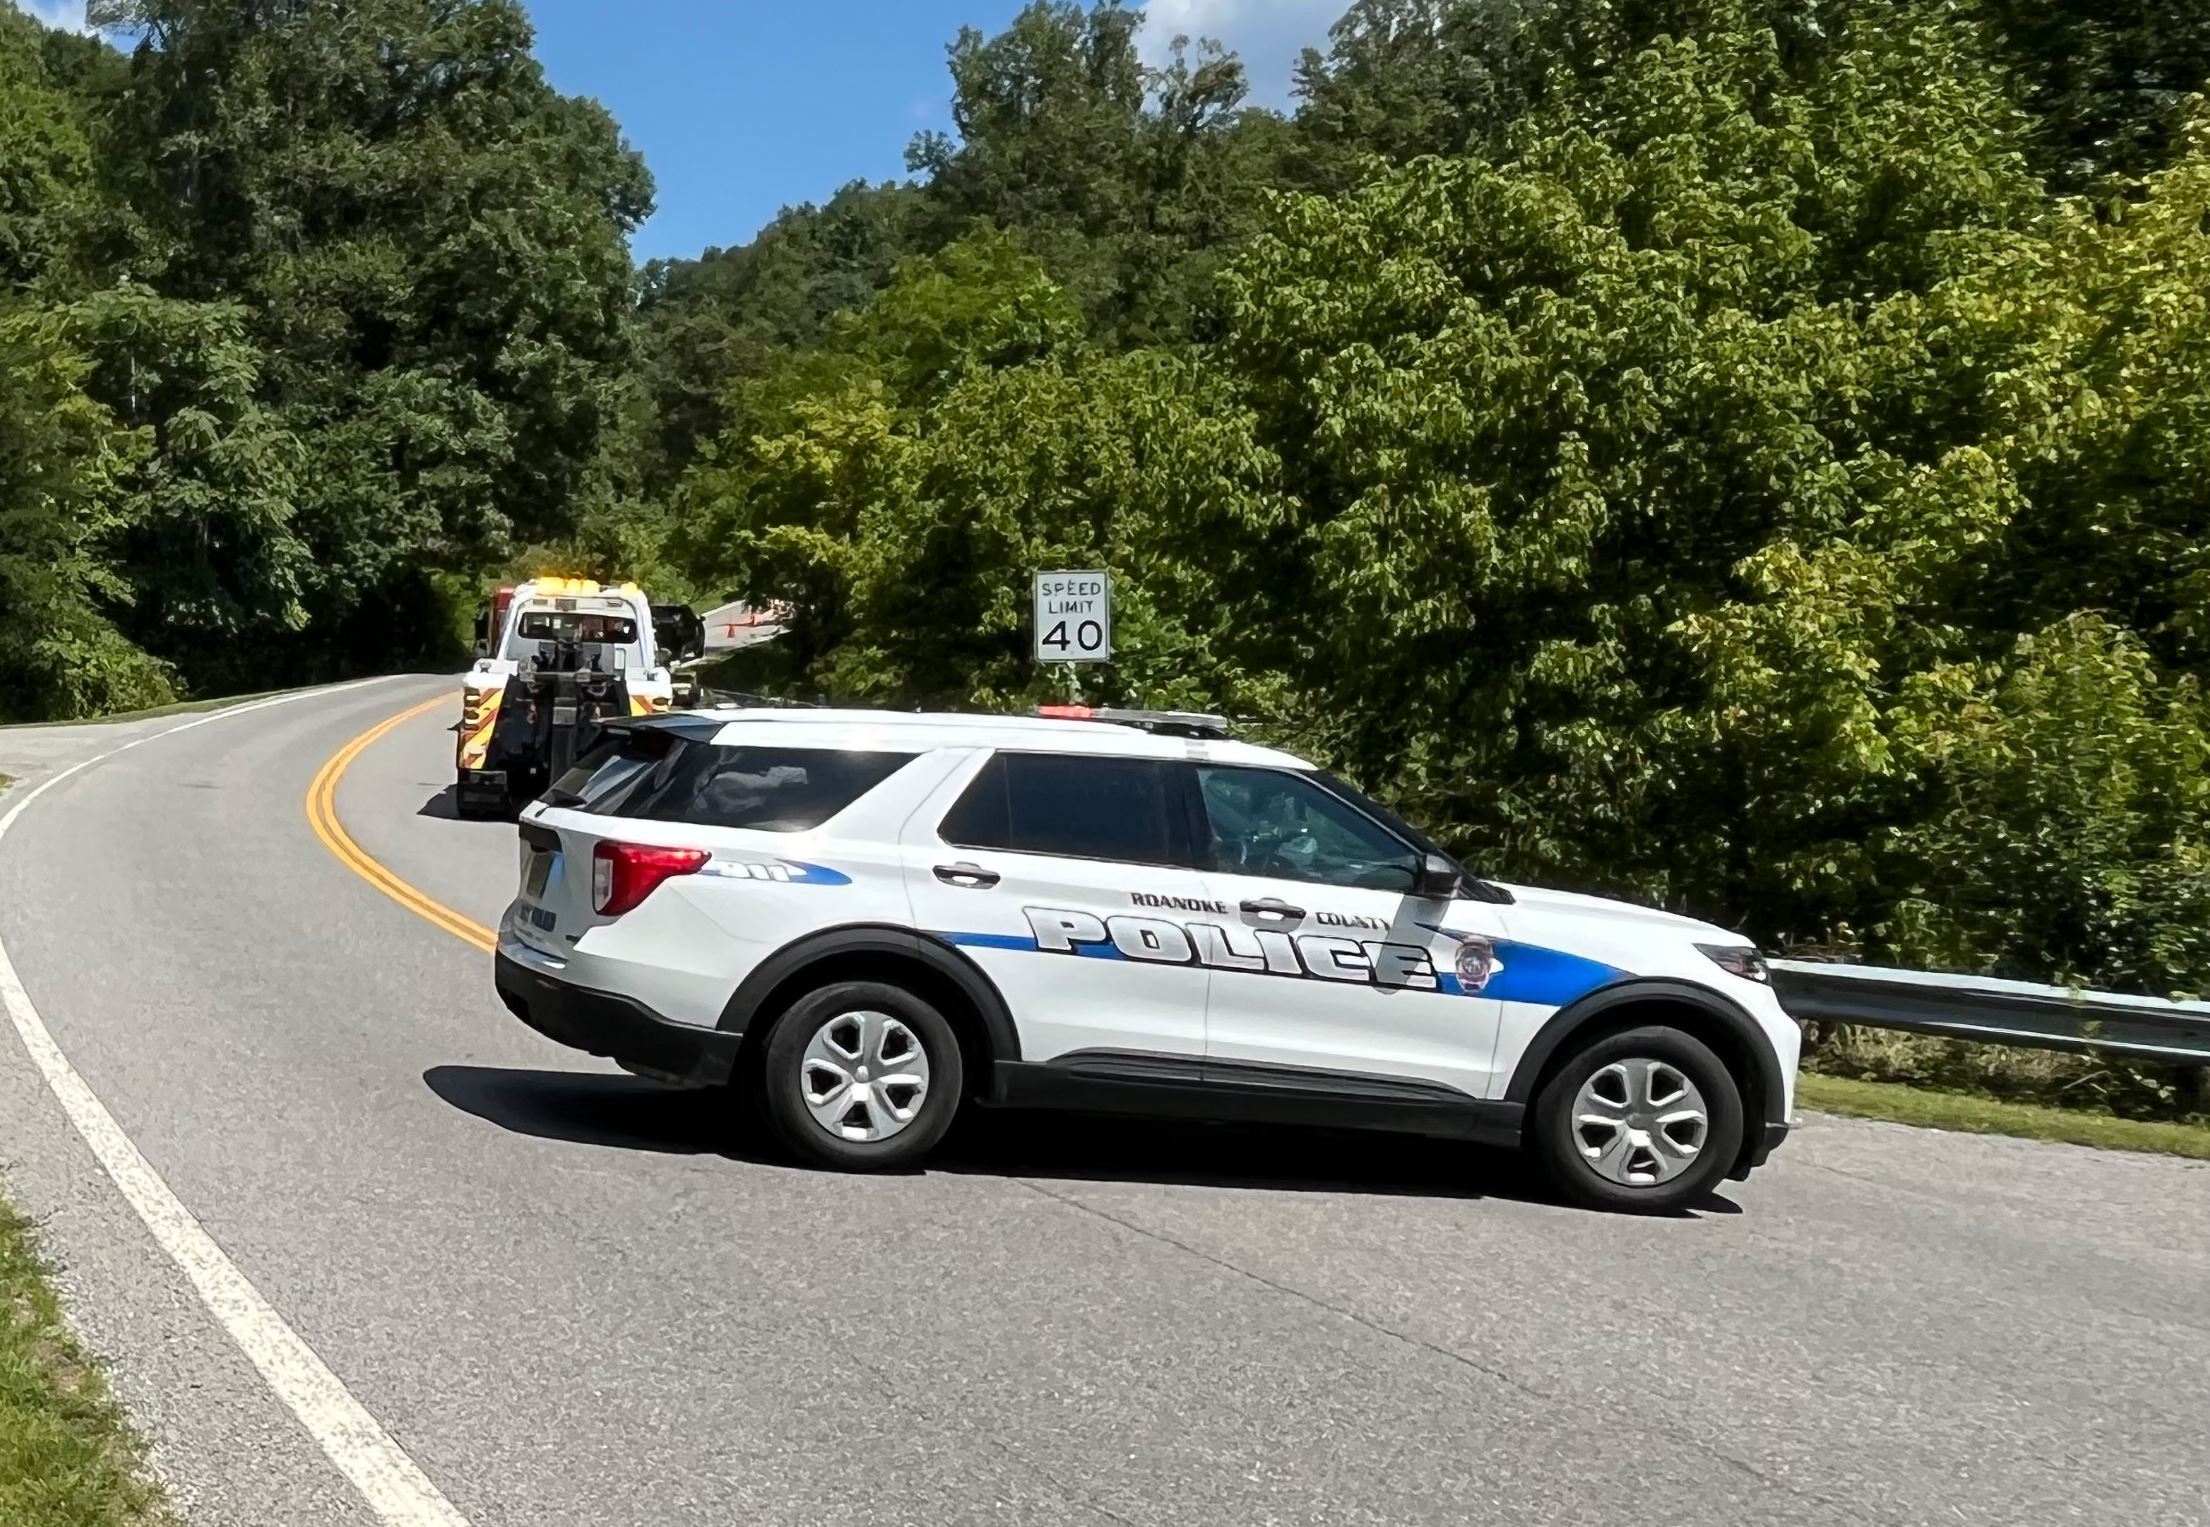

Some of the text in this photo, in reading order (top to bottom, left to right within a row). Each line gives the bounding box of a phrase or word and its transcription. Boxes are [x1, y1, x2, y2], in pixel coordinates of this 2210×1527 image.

[1041, 581, 1101, 596] SPEED
[1048, 600, 1094, 614] LIMIT
[1041, 620, 1103, 651] 40
[1130, 892, 1229, 914] ROANOKE
[1022, 906, 1442, 992] POLICE
